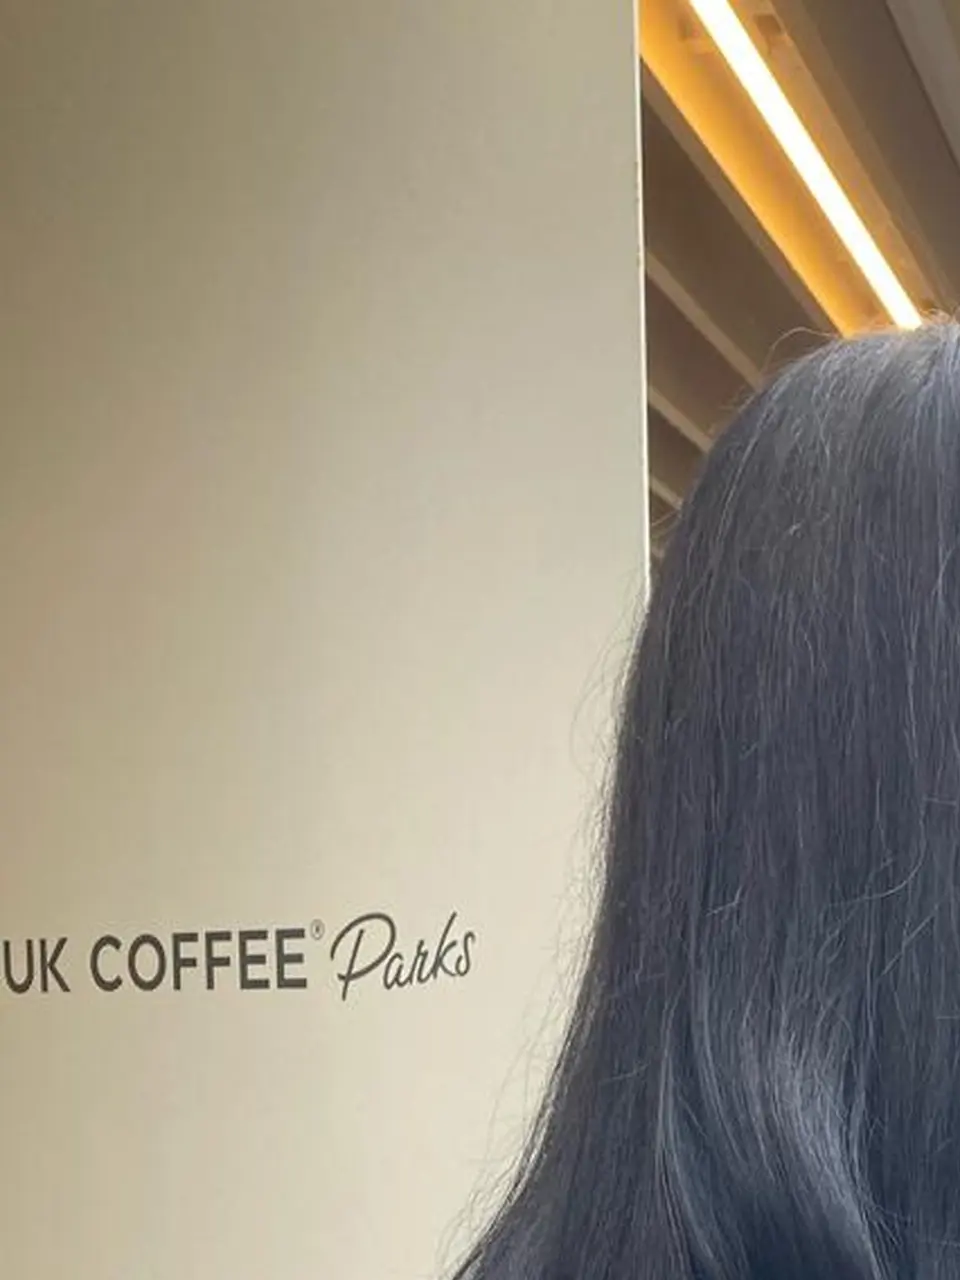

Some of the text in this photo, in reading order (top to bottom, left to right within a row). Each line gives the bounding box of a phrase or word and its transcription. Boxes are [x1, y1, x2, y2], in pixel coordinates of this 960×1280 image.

[3, 912, 475, 1001] UK COFFEE Parks
